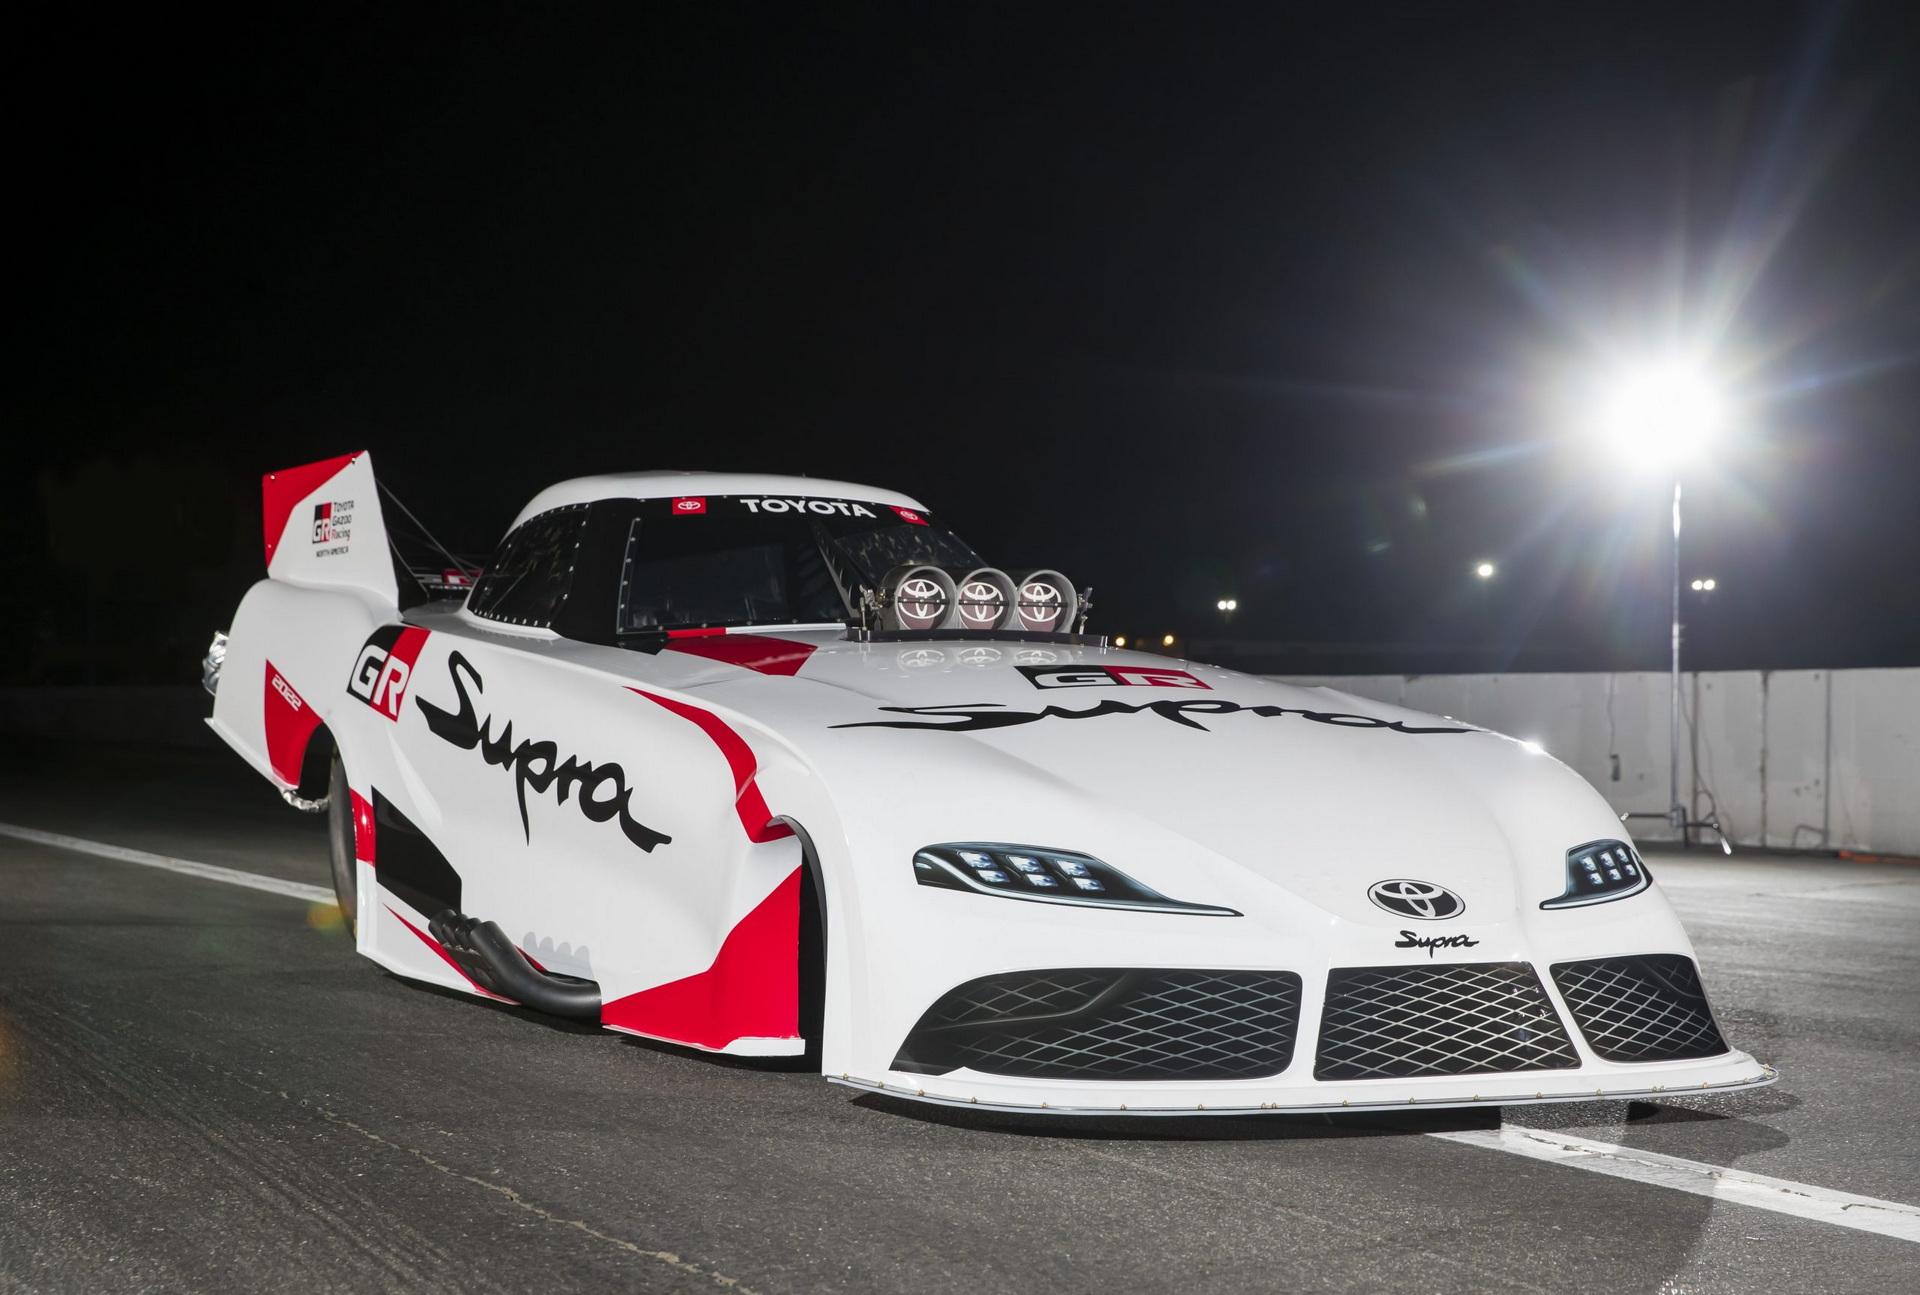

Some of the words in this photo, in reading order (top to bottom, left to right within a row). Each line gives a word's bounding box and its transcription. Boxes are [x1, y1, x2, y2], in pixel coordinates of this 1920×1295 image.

[740, 499, 877, 518] TOYOTA
[271, 674, 302, 712] 2022
[350, 644, 410, 717] GR
[1034, 671, 1208, 688] GR
[827, 699, 1483, 734] Supra
[415, 650, 672, 853] Supra
[1394, 930, 1480, 958] Supra
